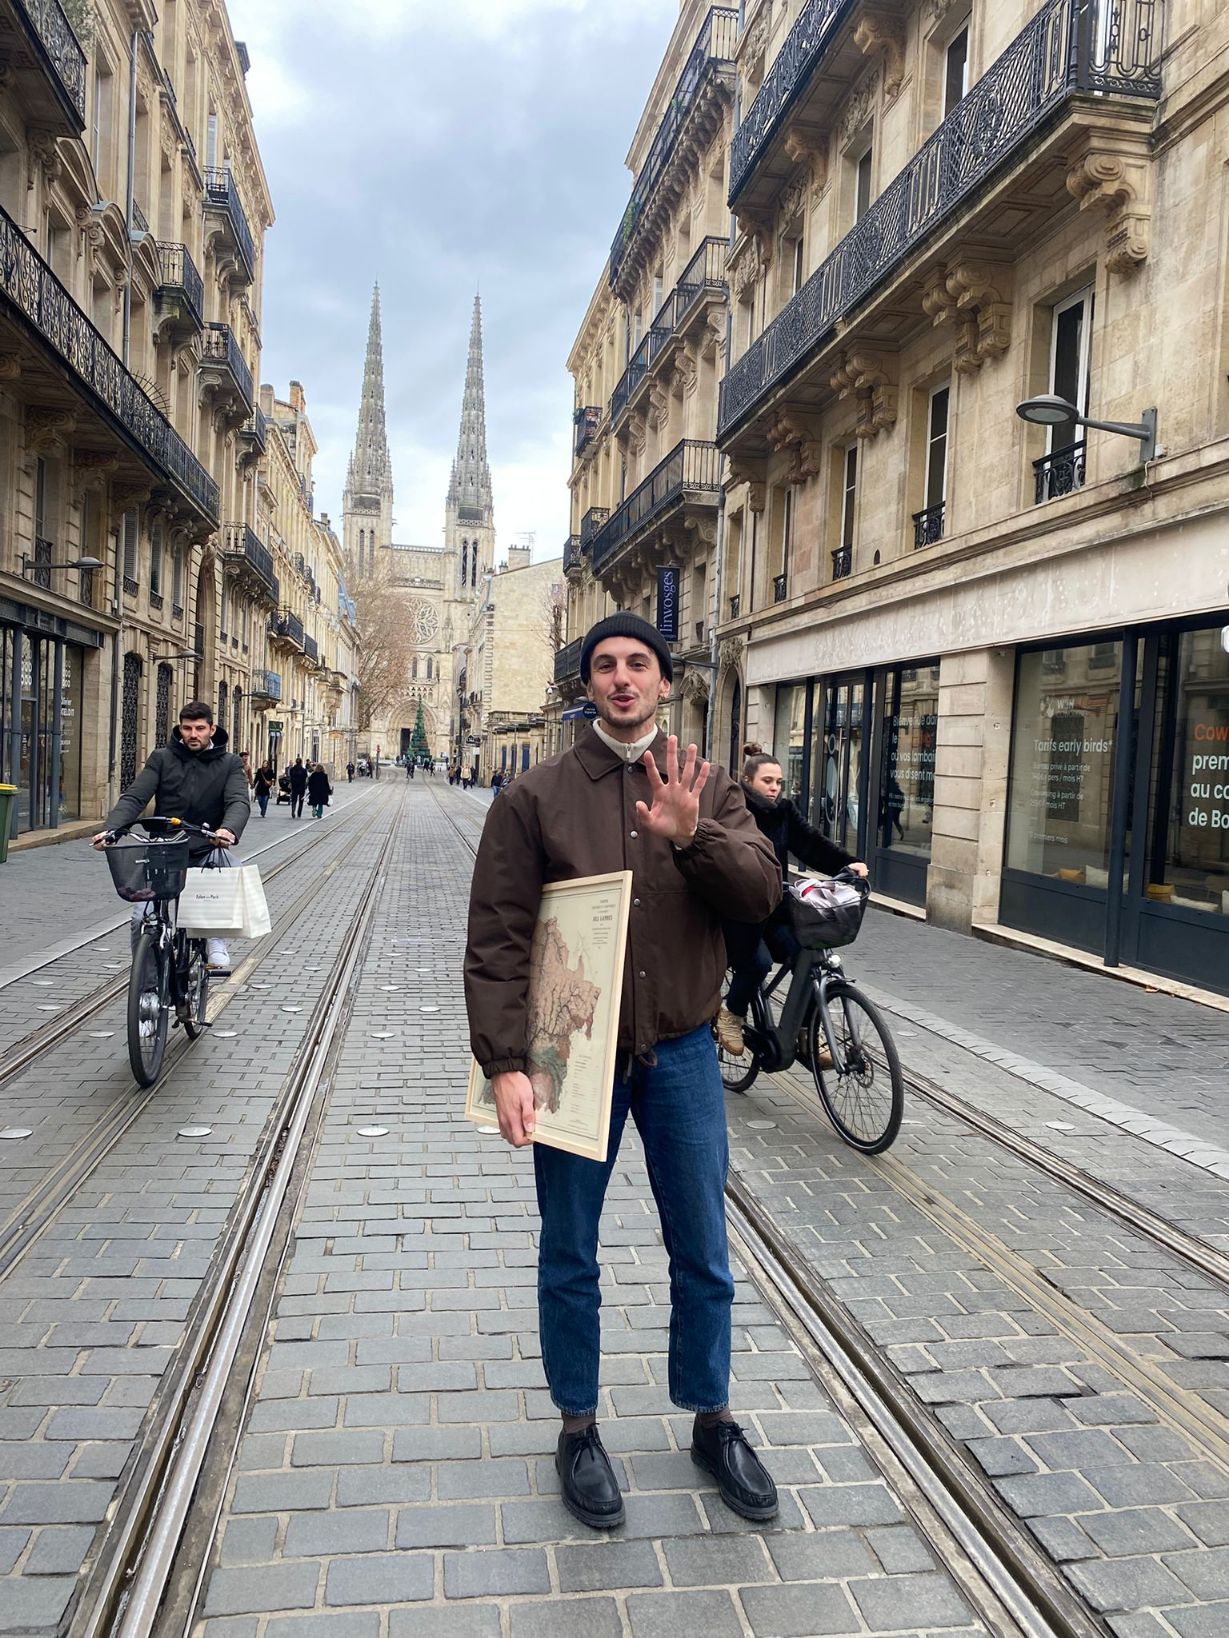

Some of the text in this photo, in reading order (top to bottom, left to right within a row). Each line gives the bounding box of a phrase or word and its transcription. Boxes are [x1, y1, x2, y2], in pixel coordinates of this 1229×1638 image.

[660, 571, 676, 632] linvosges
[1058, 738, 1082, 756] early
[1190, 783, 1210, 798] au
[1188, 807, 1208, 827] de
